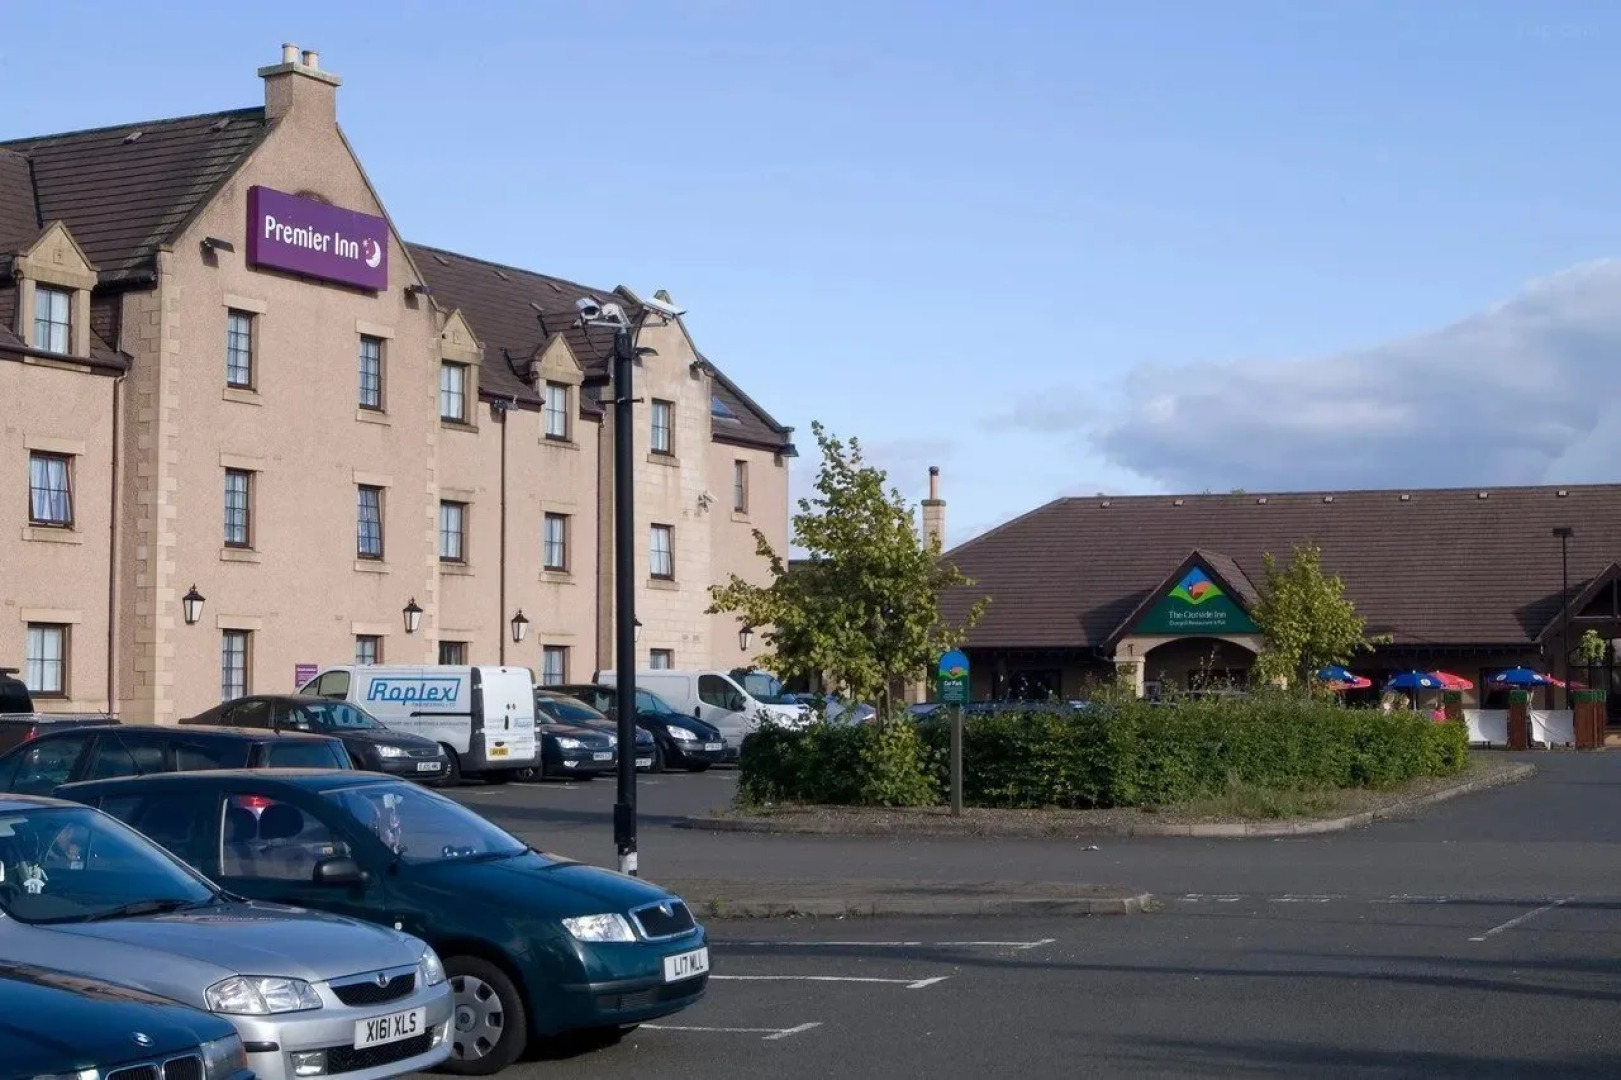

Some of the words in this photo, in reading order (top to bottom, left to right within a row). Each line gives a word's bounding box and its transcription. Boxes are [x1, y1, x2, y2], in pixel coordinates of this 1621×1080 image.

[265, 214, 331, 253] Premier
[334, 232, 359, 260] Inn
[1168, 610, 1182, 619] The
[1183, 610, 1213, 619] Outside
[1213, 610, 1227, 619] Inn
[373, 682, 452, 706] Roplex
[673, 955, 688, 977] L17
[689, 950, 704, 970] MLL
[366, 1018, 391, 1043] X161
[394, 1012, 416, 1036] XLS
